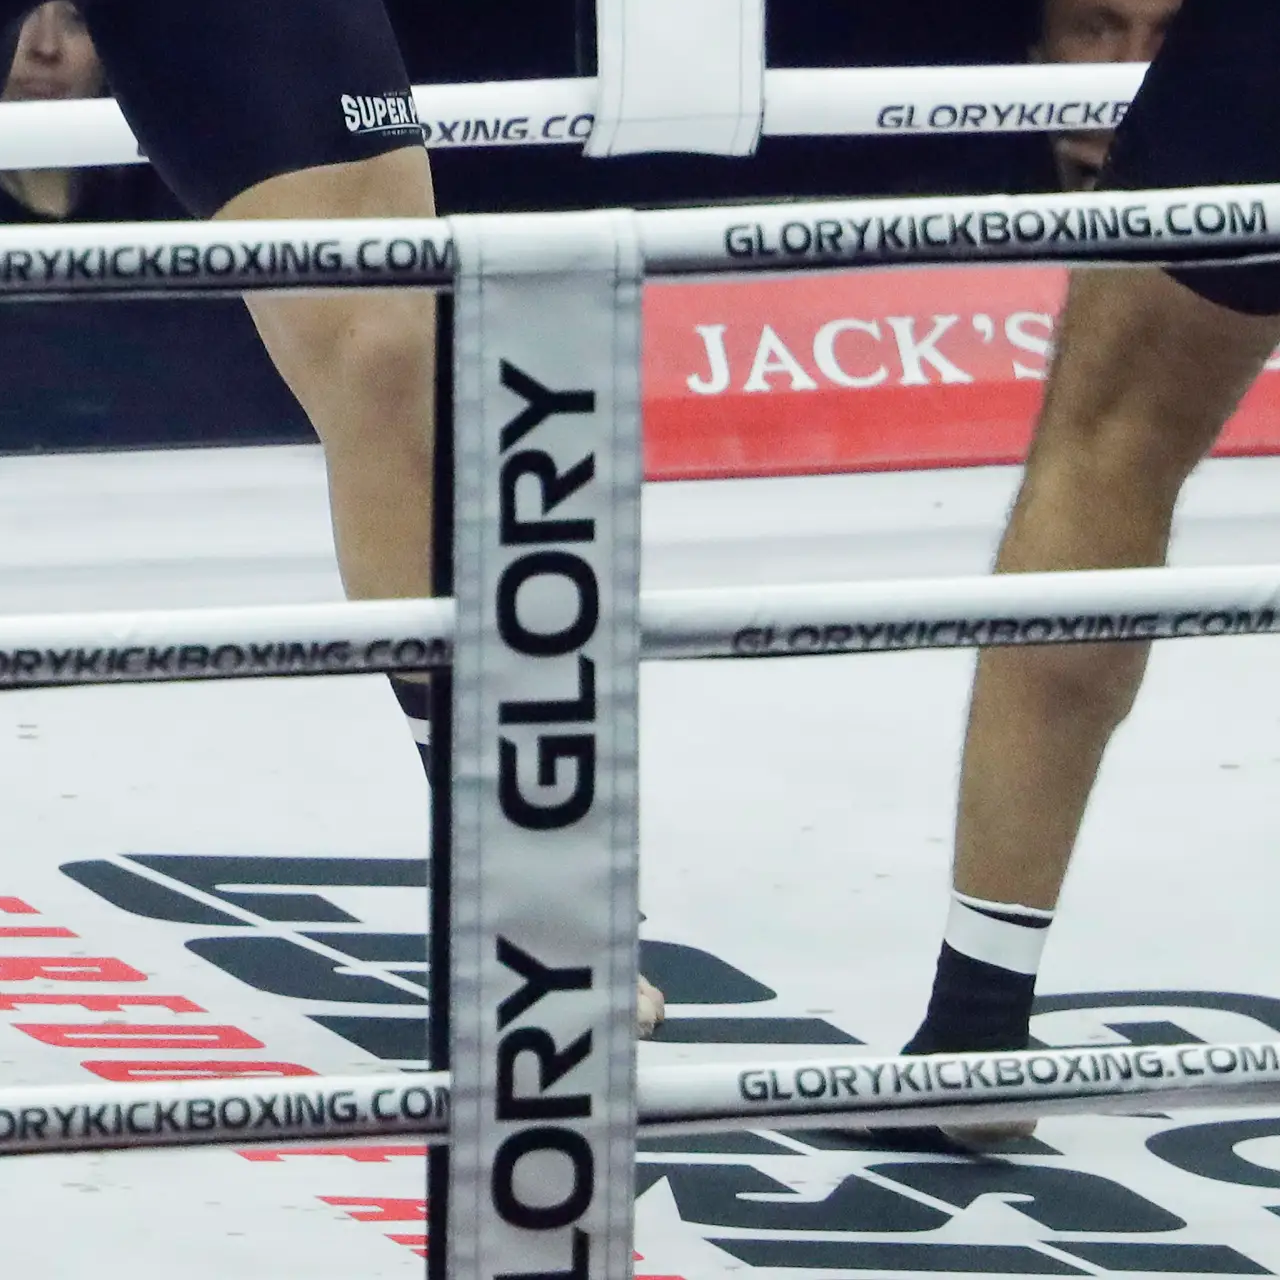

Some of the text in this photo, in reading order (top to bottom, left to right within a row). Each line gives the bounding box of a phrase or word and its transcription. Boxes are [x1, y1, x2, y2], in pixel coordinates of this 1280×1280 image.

[341, 94, 410, 132] SUPER
[724, 200, 1267, 258] GLORYKICKBOXING.COM
[686, 311, 1054, 396] JACK'S
[496, 357, 599, 831] GLORY
[738, 1045, 1280, 1102] GLORYKICKBOXING.COM
